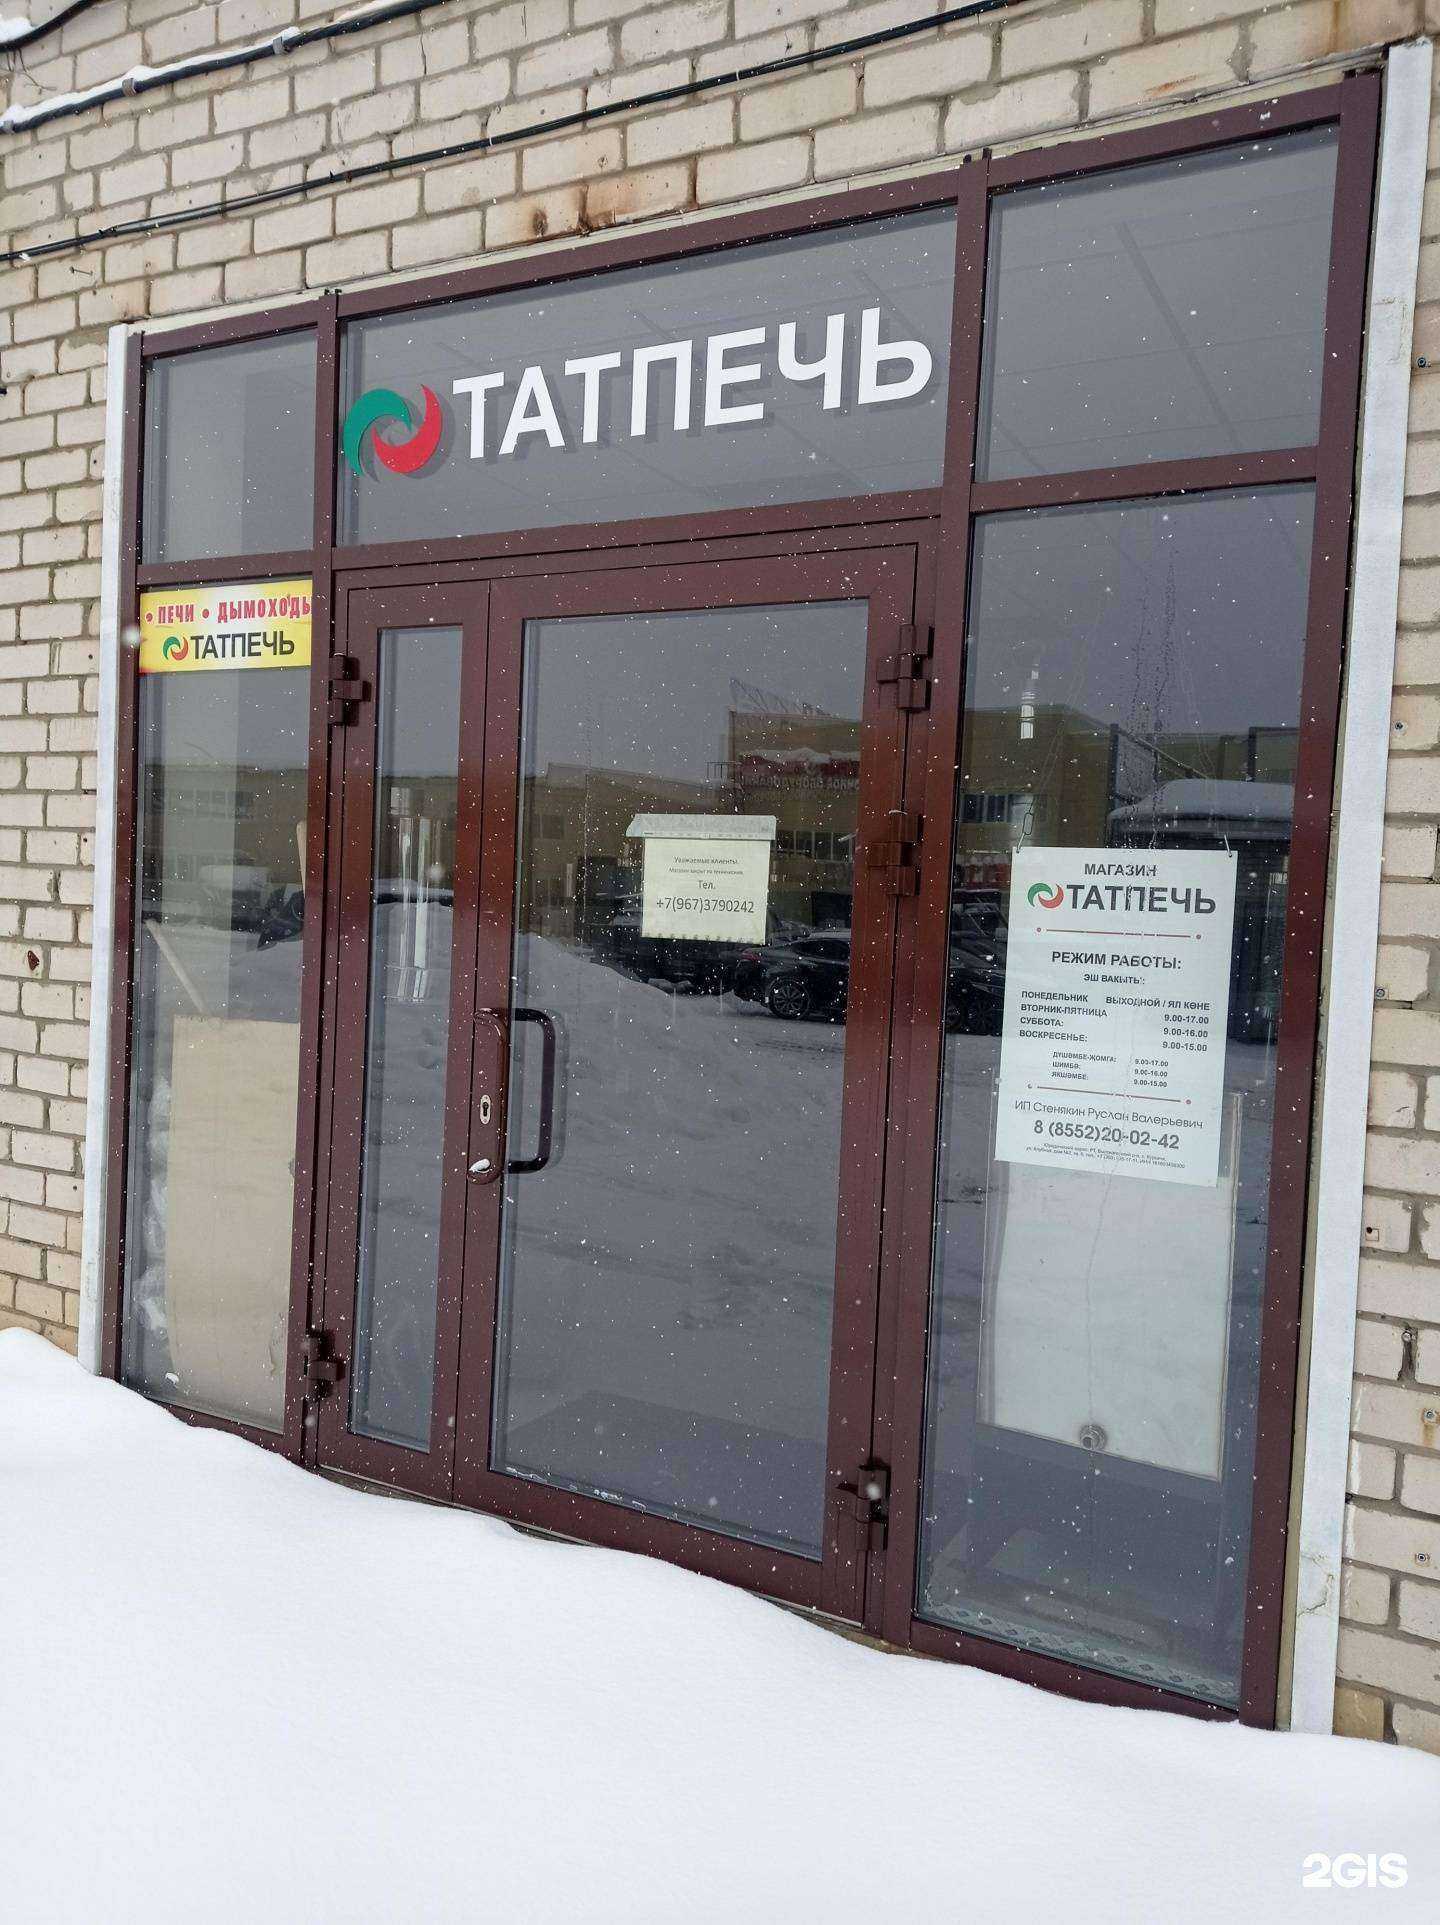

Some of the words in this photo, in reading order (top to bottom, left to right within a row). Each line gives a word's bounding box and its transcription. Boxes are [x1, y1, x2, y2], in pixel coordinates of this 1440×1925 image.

[452, 307, 933, 459] ТАТПЕЧЬ
[157, 603, 195, 624] ПЕЧИ
[190, 630, 295, 660] ТАТПЕЧЬ
[1084, 863, 1157, 877] МАГАЗИН
[698, 879, 716, 890] Тел.
[656, 896, 755, 914] +7(967)3790242
[1066, 884, 1217, 914] ТАТПЕЧЬ
[1051, 951, 1106, 966] РЕЖИМ
[1110, 953, 1182, 970] РАБОТЫ:
[1083, 973, 1099, 982] ЭШ
[1021, 990, 1089, 1002] ПОНЕДЕЛЬНИК
[1105, 996, 1161, 1008] ВЫХОДНОЙ
[1020, 1003, 1108, 1018] ВТОРНИК-ПЯТНИЦА
[1164, 1014, 1209, 1025] 9.00-17.00
[1020, 1016, 1064, 1027] СУББОТА:
[1163, 1027, 1208, 1038] 9.00-16.00
[1019, 1029, 1088, 1042] ВОСКРЕСЕНЬЕ:
[1162, 1041, 1208, 1052] 9.00-15.00
[1015, 1099, 1031, 1111] ИП
[1033, 1101, 1085, 1117] Стенякин
[1087, 1107, 1129, 1120] Руслан
[1131, 1111, 1204, 1129] Валерьевич
[1033, 1119, 1044, 1134] 8
[1048, 1121, 1180, 1150] (8552)20-02-42
